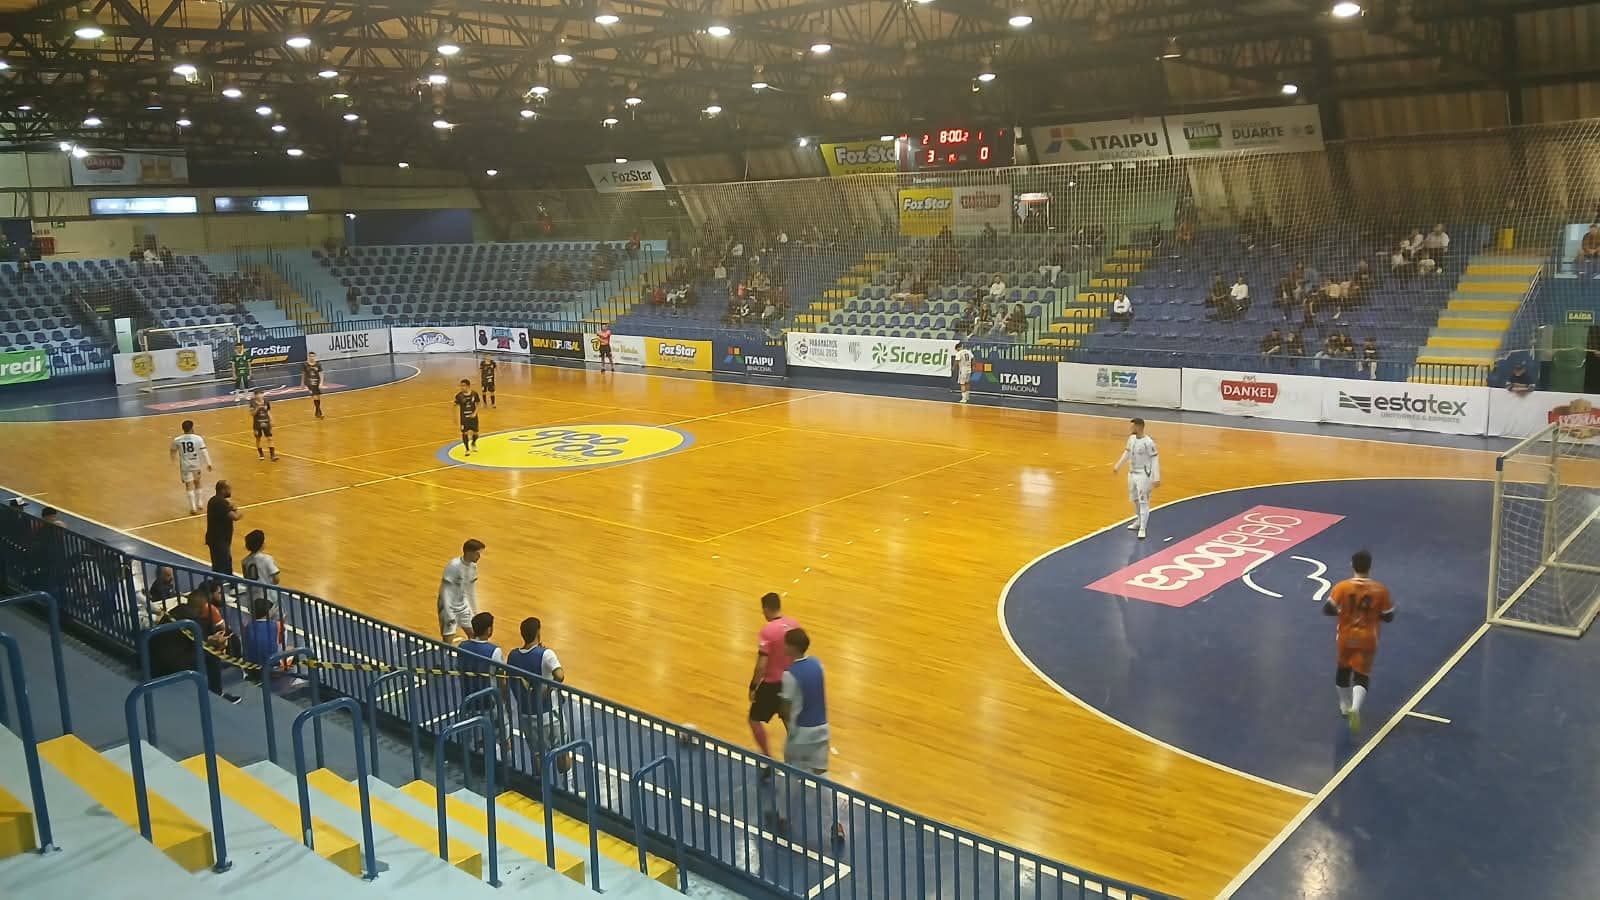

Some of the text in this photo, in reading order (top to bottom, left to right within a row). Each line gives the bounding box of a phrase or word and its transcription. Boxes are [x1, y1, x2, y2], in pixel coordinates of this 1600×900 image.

[1089, 131, 1158, 150] ITAIPU
[1231, 125, 1285, 140] DUARTE
[834, 143, 896, 166] FozSta
[927, 149, 935, 163] 3
[980, 146, 989, 160] 0
[611, 169, 653, 183] FozStar
[903, 195, 952, 211] FozStar
[329, 333, 369, 352] JAUENSE
[658, 343, 697, 358] FozStar
[250, 345, 292, 357] FozStar
[889, 346, 949, 366] Sicredi
[0, 355, 41, 377] redi
[744, 355, 774, 367] ITAIPU
[999, 372, 1041, 386] ITAIPU
[1223, 384, 1275, 398] DANKEL
[1373, 391, 1468, 416] estatex
[181, 440, 195, 454] 18
[1124, 512, 1303, 591] gelaboca
